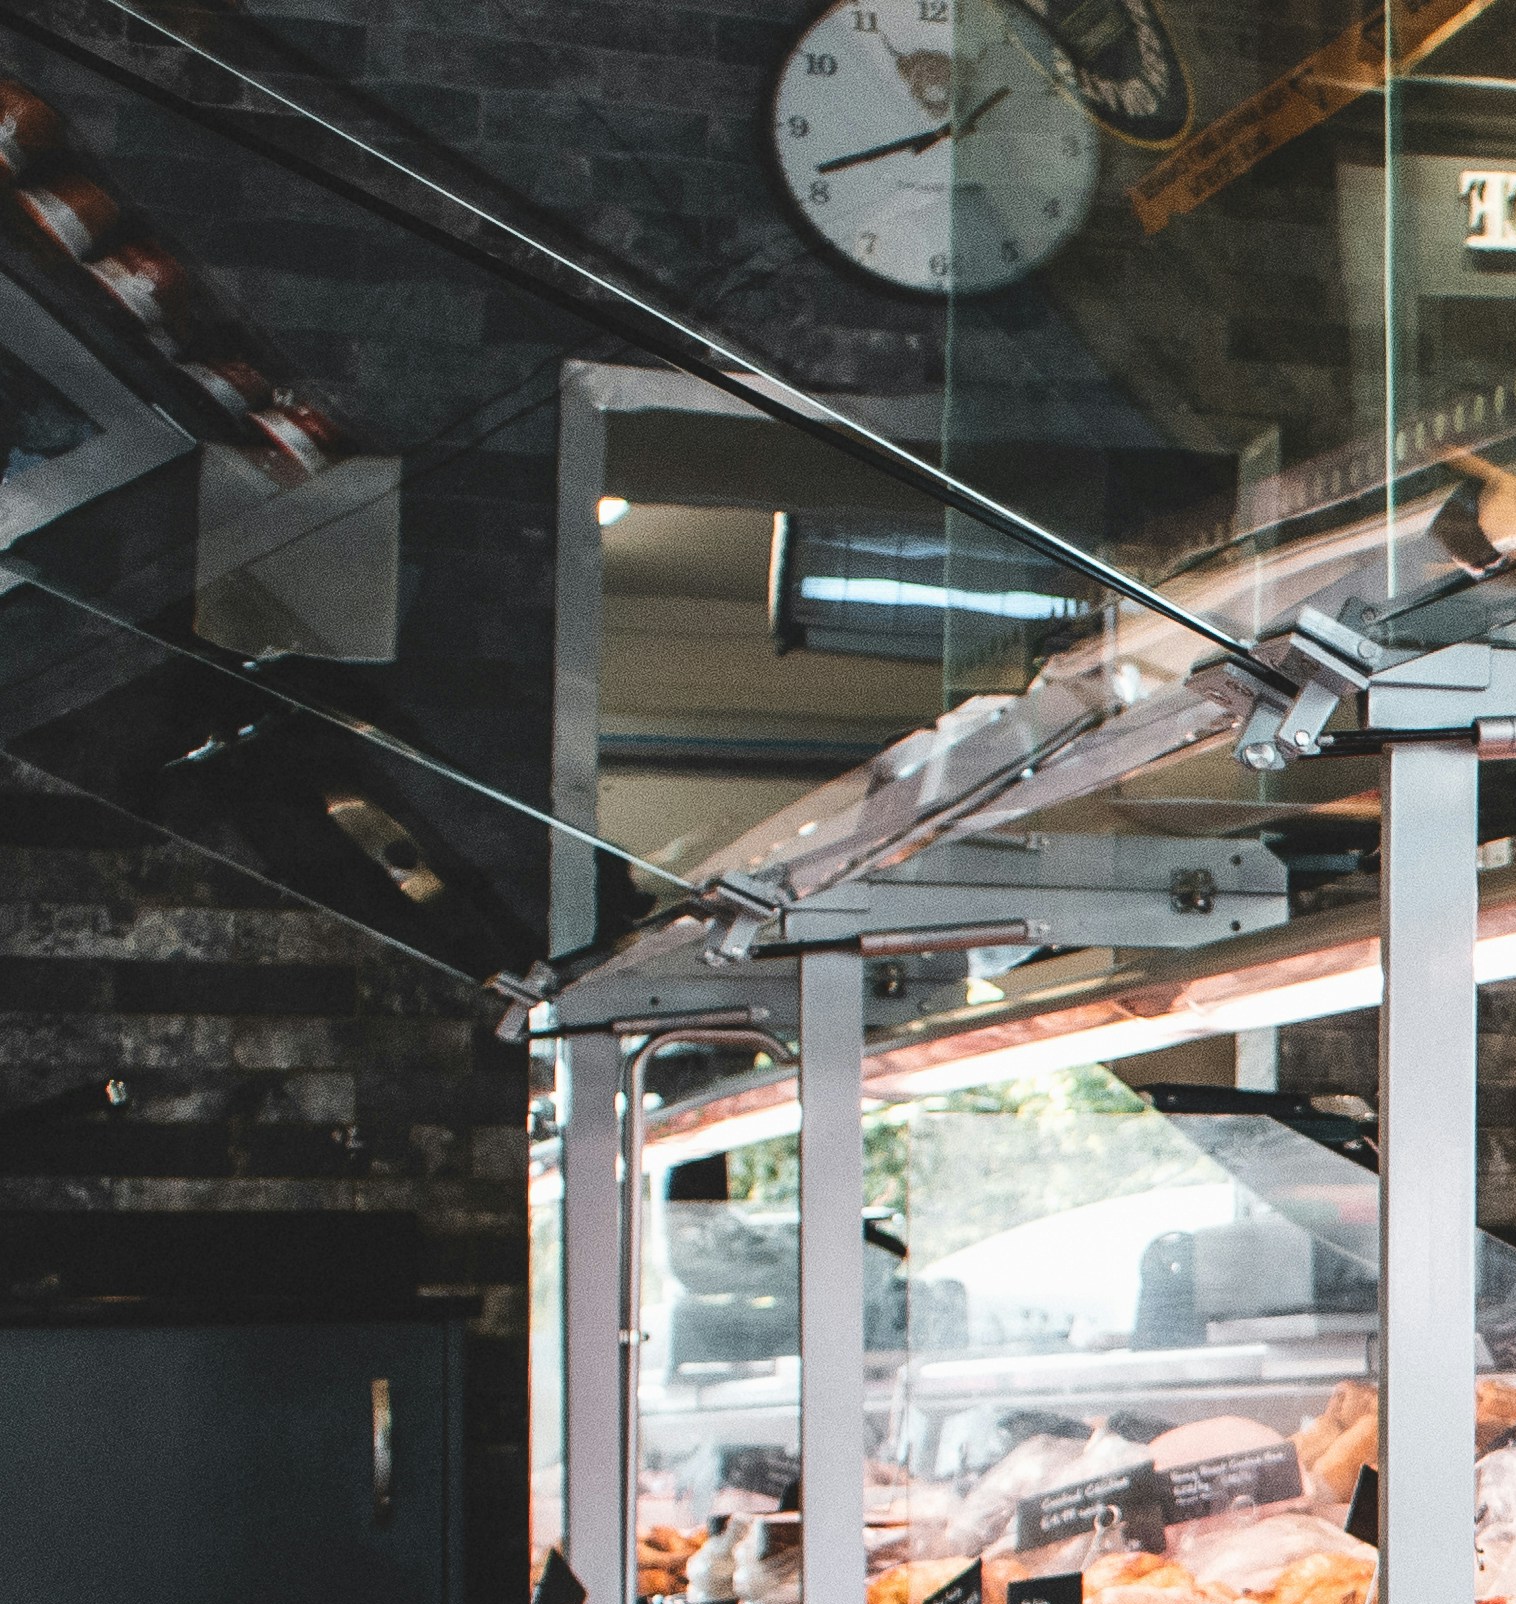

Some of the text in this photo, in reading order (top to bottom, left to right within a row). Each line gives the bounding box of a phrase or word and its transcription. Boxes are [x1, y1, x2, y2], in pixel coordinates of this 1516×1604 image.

[853, 10, 879, 34] 11
[805, 53, 838, 78] 10
[788, 114, 811, 139] 9
[809, 180, 831, 204] 8
[855, 231, 877, 255] 7
[928, 253, 949, 277] 6
